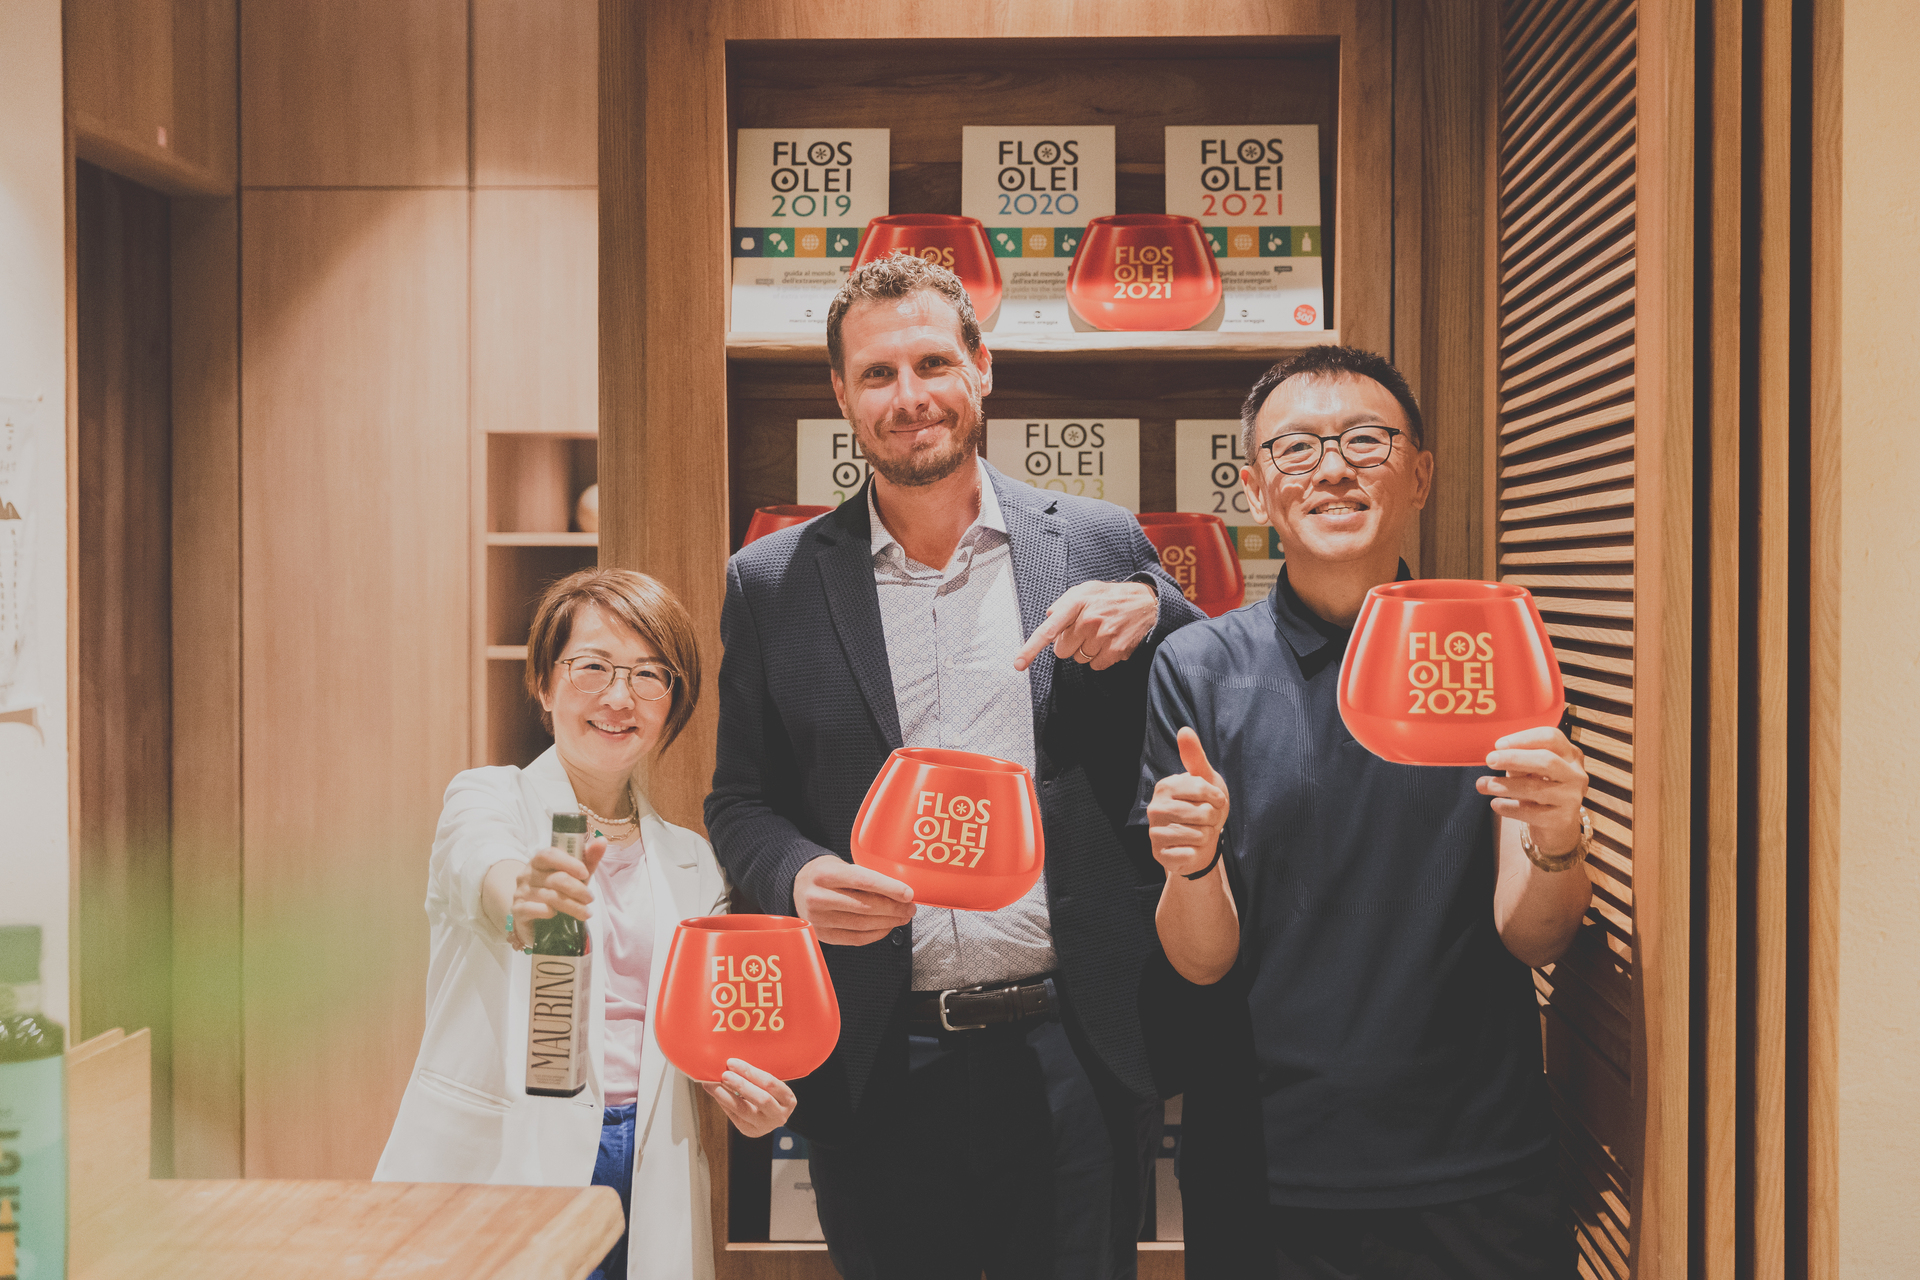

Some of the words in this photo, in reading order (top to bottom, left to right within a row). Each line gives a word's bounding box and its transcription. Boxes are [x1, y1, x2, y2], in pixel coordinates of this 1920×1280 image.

[773, 141, 853, 166] FLOS
[998, 140, 1079, 165] FLOS
[1201, 138, 1284, 165] FLOS
[771, 168, 852, 193] OLEI
[998, 167, 1078, 192] OLEI
[1201, 166, 1283, 192] OLEI
[771, 195, 852, 217] 2019
[998, 193, 1079, 215] 2020
[1202, 193, 1283, 216] 2021
[1115, 245, 1174, 265] FLOS
[1114, 264, 1174, 283] OLEI
[1113, 282, 1172, 299] 2021
[1026, 423, 1105, 449] FLOS
[1025, 451, 1103, 476] OLEI
[1408, 631, 1494, 661] FLOS
[1408, 661, 1494, 689] OLEI
[1407, 689, 1497, 715] 2025
[917, 790, 992, 824] FLOS
[913, 816, 989, 848] OLEI
[908, 839, 986, 869] 2027
[711, 955, 782, 982] FLOS
[711, 982, 784, 1008] OLEI
[530, 961, 576, 1073] MAURINO
[711, 1008, 785, 1032] 2026
